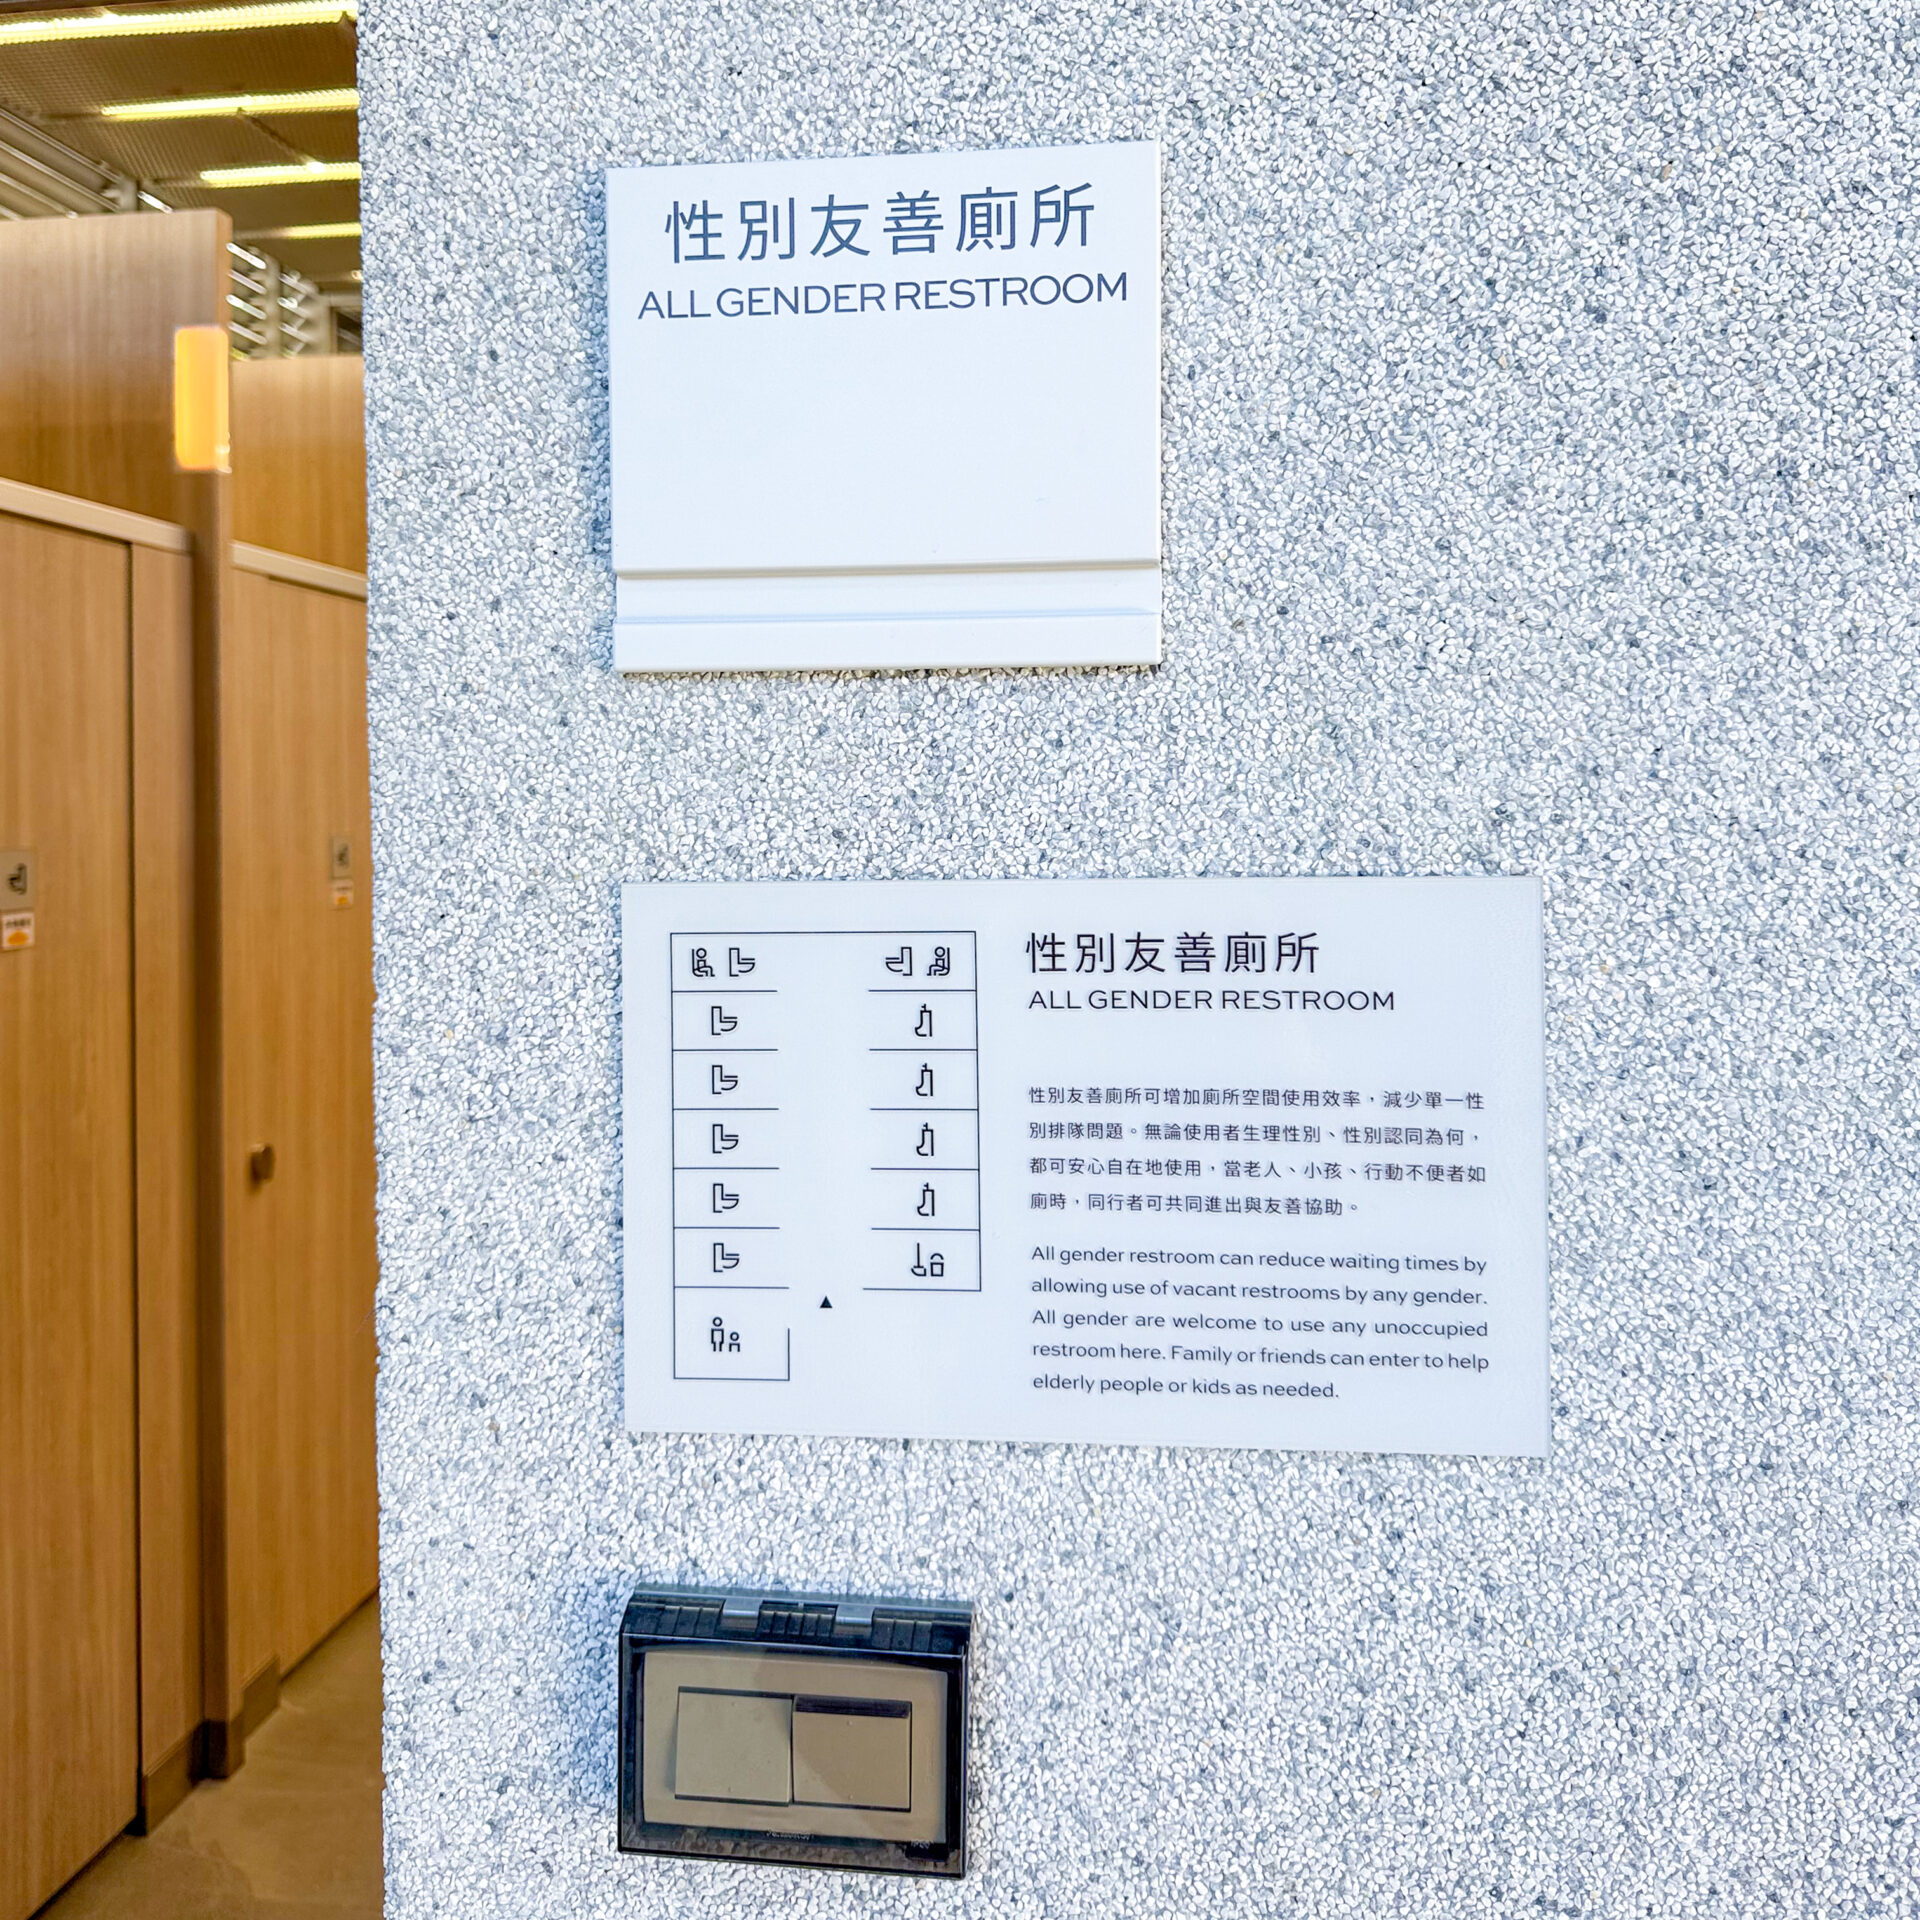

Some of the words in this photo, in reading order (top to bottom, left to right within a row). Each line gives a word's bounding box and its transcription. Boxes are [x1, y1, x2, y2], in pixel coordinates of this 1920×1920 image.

[664, 182, 1095, 264] 性別友善廁所
[637, 289, 712, 320] ALL
[716, 282, 886, 318] GENDER
[895, 271, 1127, 311] RESTROOM
[1025, 930, 1320, 974] 性別友善廁所
[1027, 989, 1083, 1010] ALL
[1087, 989, 1213, 1010] GENDER
[1221, 989, 1395, 1011] RESTROOM
[1031, 1245, 1055, 1261] All
[1059, 1246, 1125, 1266] gender
[1129, 1249, 1215, 1265] restroom
[1219, 1253, 1254, 1266] can
[1258, 1251, 1326, 1268] reduce
[1329, 1252, 1400, 1274] waiting
[1403, 1254, 1460, 1272] times
[1463, 1255, 1488, 1277] by
[1031, 1277, 1108, 1299] allowing
[1112, 1282, 1146, 1295] use
[1149, 1279, 1169, 1296] of
[1172, 1283, 1237, 1298] vacant
[1241, 1284, 1341, 1301] restrooms
[1345, 1285, 1369, 1305] by
[1372, 1289, 1409, 1306] any
[1412, 1288, 1488, 1308] gender.
[1031, 1309, 1056, 1325] All
[1062, 1310, 1129, 1330] gender
[1134, 1315, 1166, 1328] are
[1172, 1313, 1257, 1331] welcome
[1263, 1316, 1284, 1332] to
[1290, 1320, 1325, 1333] use
[1331, 1321, 1367, 1338] any
[1374, 1320, 1488, 1340] unoccupied
[1032, 1343, 1116, 1359] restroom
[1120, 1343, 1166, 1360] here.
[1171, 1345, 1233, 1366] Family
[1236, 1350, 1257, 1363] or
[1259, 1346, 1327, 1365] friends
[1329, 1353, 1365, 1366] can
[1368, 1352, 1421, 1368] enter
[1423, 1353, 1444, 1369] to
[1448, 1352, 1490, 1374] help
[1032, 1373, 1096, 1394] elderly
[1100, 1376, 1164, 1396] people
[1168, 1381, 1188, 1393] or
[1192, 1378, 1231, 1395] kids
[1234, 1383, 1258, 1396] as
[1262, 1381, 1339, 1398] needed.
